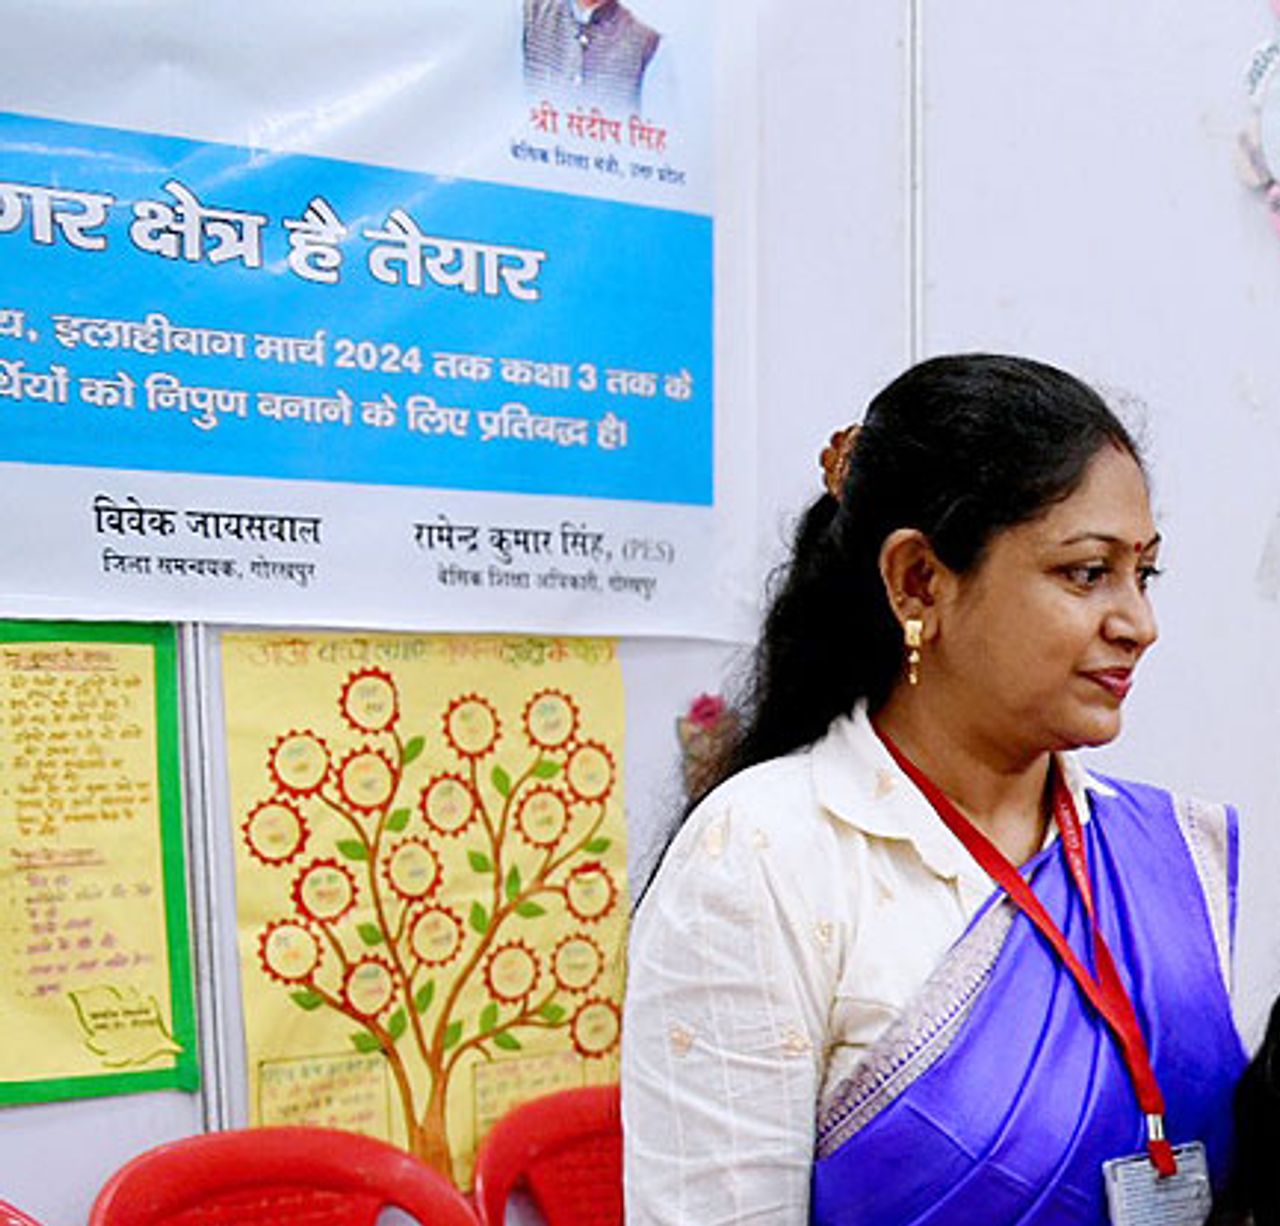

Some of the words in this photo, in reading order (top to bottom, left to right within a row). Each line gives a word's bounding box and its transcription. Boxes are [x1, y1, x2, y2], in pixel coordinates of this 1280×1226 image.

[530, 101, 560, 135] श्री
[566, 105, 622, 144] संदीप
[628, 114, 667, 153] सिंह
[129, 178, 267, 269] क्षेत्र
[283, 196, 348, 284] है
[362, 207, 548, 302] तैयार
[254, 329, 327, 368] मार्च
[334, 338, 423, 375] 2024
[433, 352, 494, 382] तक
[501, 357, 571, 390] कक्षा
[577, 363, 597, 392] 3
[606, 369, 656, 398] तक
[664, 367, 694, 402] के
[79, 372, 136, 409] को
[145, 373, 248, 430] निपुण
[257, 390, 353, 426] बनाने
[361, 394, 397, 428] के
[407, 396, 469, 438] लिए
[94, 494, 177, 537] विवेक
[186, 510, 322, 544] जायसवाल
[413, 514, 479, 552] रामेन्द्र
[488, 527, 552, 565] कुमार
[621, 539, 675, 563] (PES)
[104, 547, 150, 575] जिला
[250, 554, 315, 587] गोरखपुर
